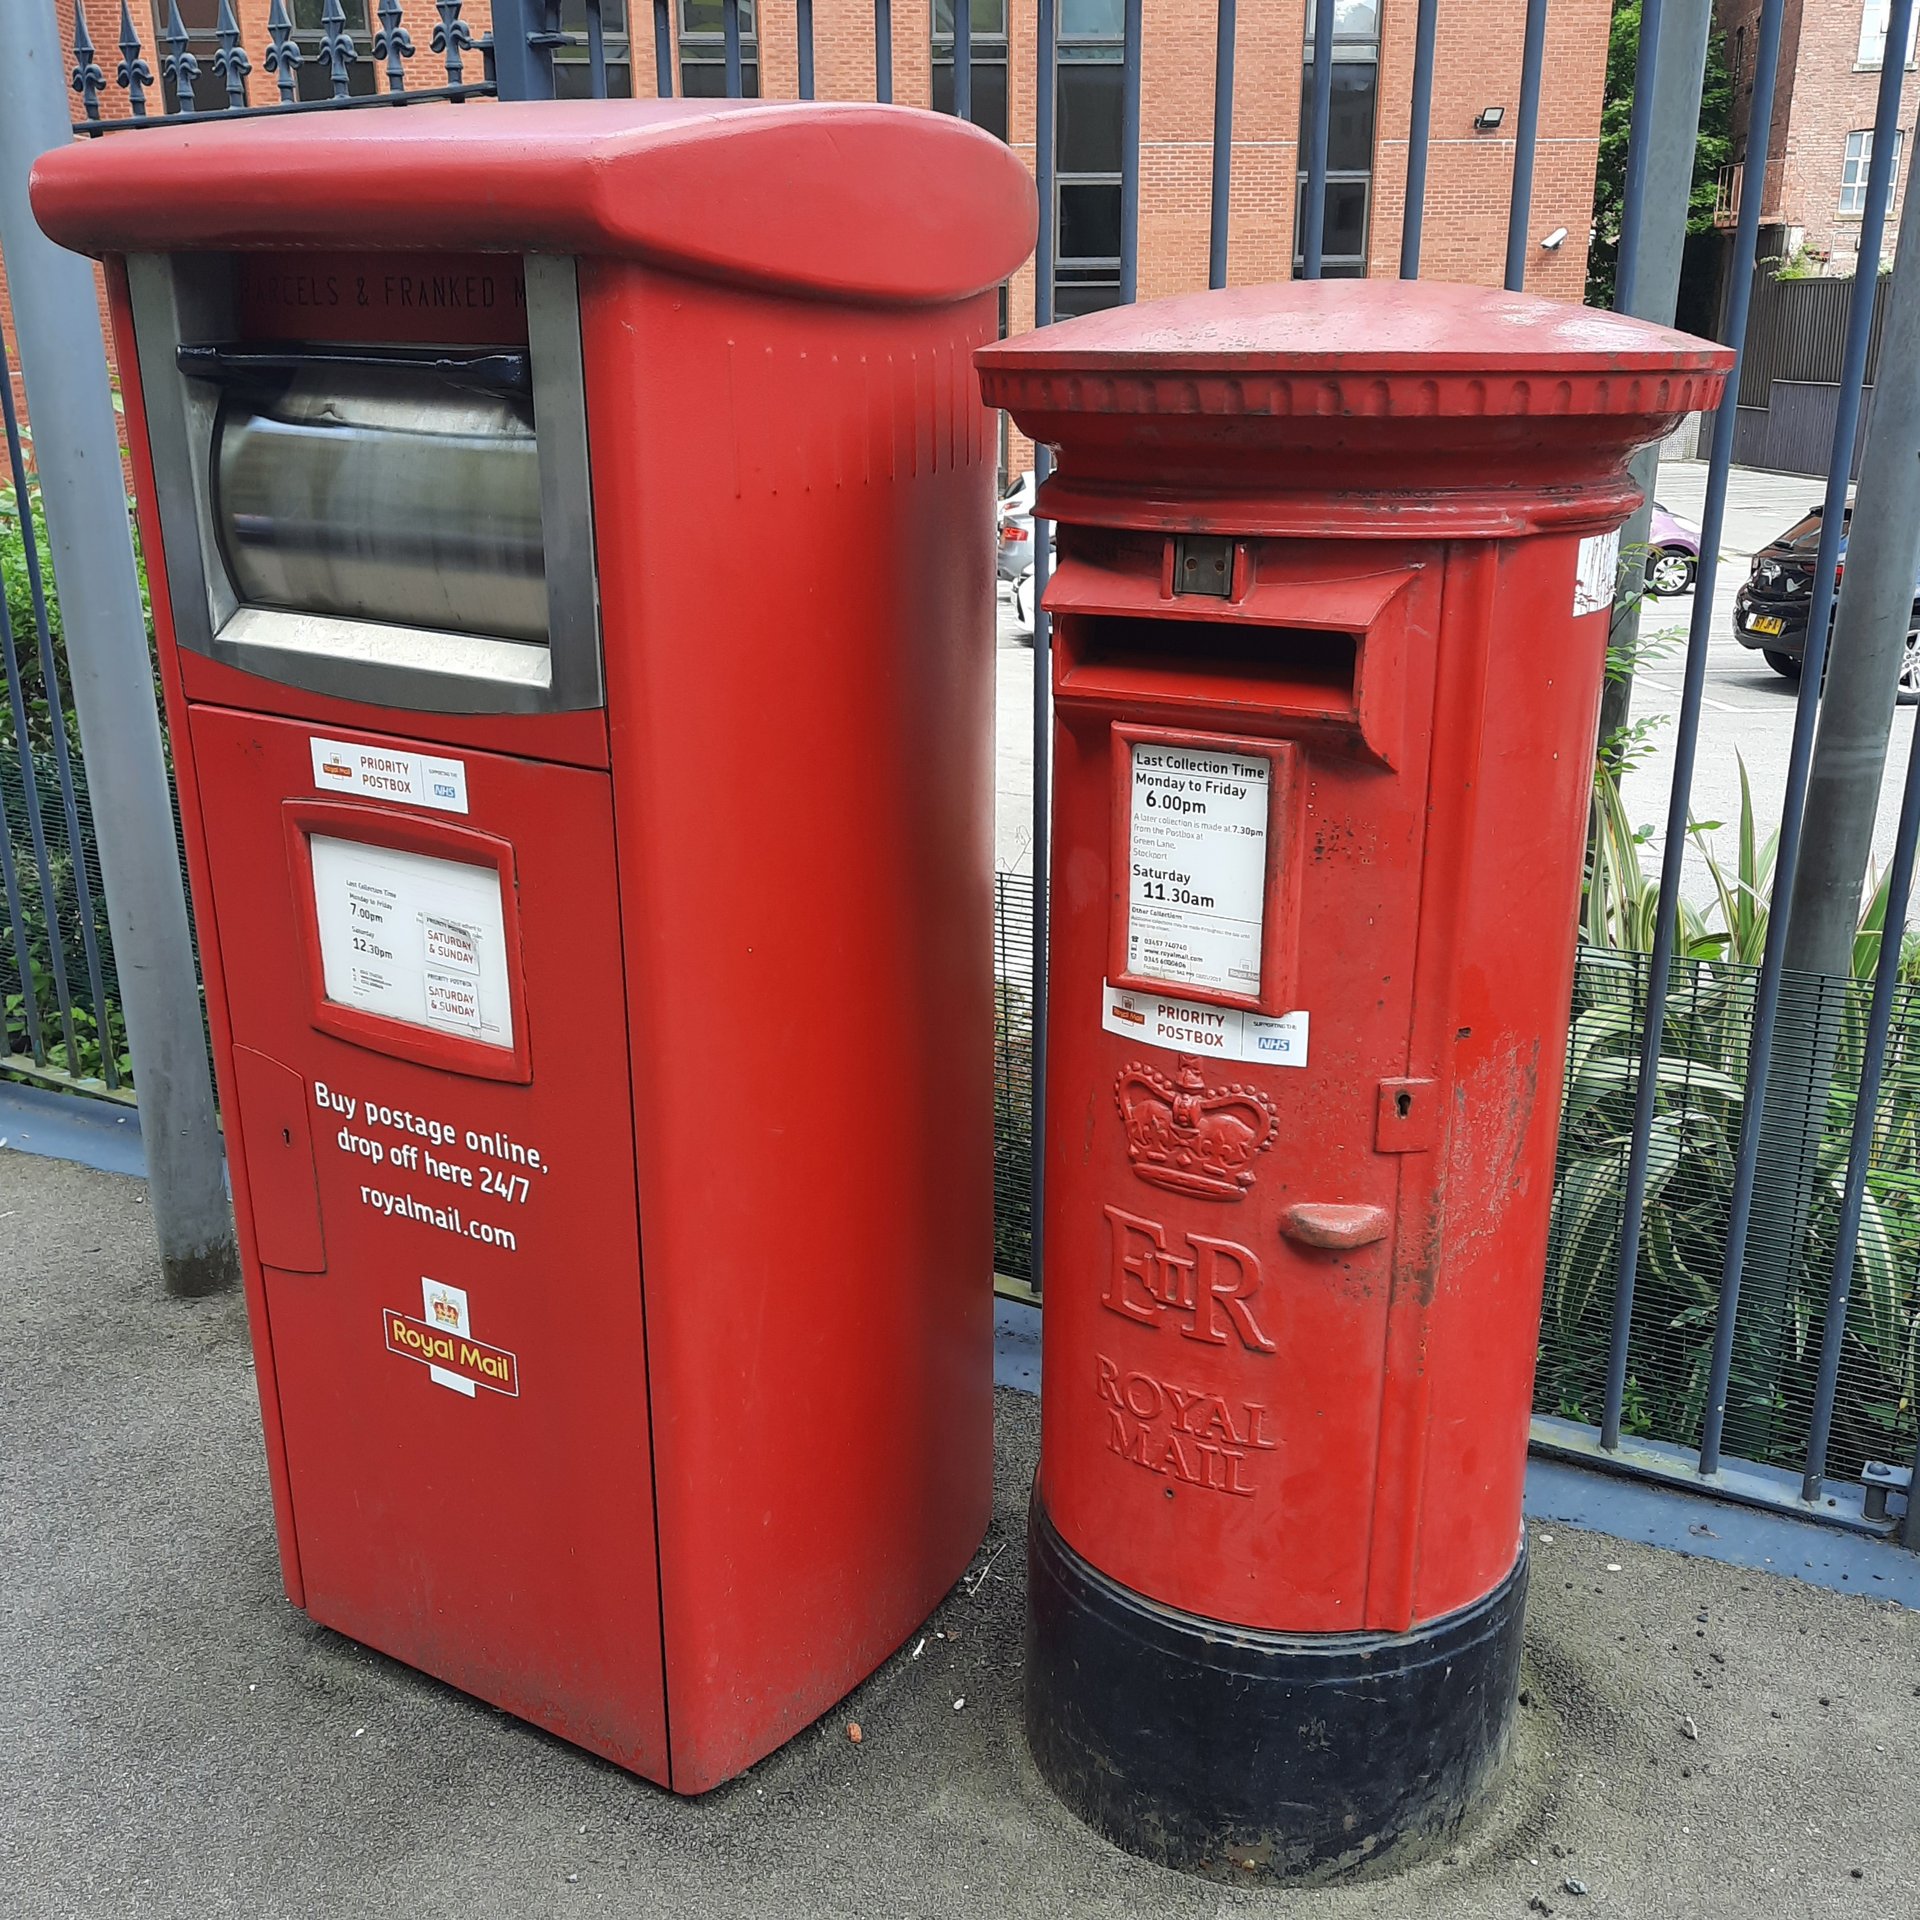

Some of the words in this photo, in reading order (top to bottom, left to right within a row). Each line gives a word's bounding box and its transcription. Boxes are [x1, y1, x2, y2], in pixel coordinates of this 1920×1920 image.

[241, 275, 338, 306] PARCELS
[357, 276, 369, 306] &
[384, 276, 495, 308] FRANKED
[360, 756, 409, 775] PRIORITY
[1136, 752, 1162, 767] Last
[1166, 756, 1228, 774] Collection
[1232, 763, 1265, 778] Time
[362, 774, 412, 793] POSTBOX
[434, 784, 455, 798] NHS
[1136, 772, 1185, 792] Monday
[1189, 780, 1202, 792] to
[1205, 781, 1247, 800] Friday
[1146, 790, 1206, 814] 6.00pm
[1133, 824, 1151, 833] from
[1152, 825, 1164, 835] the
[1166, 828, 1195, 839] Postbox
[1140, 813, 1156, 823] later
[1159, 816, 1193, 828] collection
[1193, 820, 1200, 828] is
[1201, 821, 1222, 831] made
[1232, 825, 1264, 837] 7.30pm
[1133, 835, 1155, 846] Green
[1133, 848, 1167, 860] Stockport
[1133, 863, 1191, 885] Saturday
[345, 880, 357, 888] Last
[384, 889, 397, 898] Time
[1143, 881, 1214, 908] 11.30am
[350, 902, 383, 923] 7.00pm
[1150, 909, 1182, 920] Collections
[352, 937, 393, 959] 12.30pm
[427, 929, 471, 951] SATURDAY
[429, 943, 435, 953] &
[437, 946, 474, 964] SUNDAY
[1144, 948, 1203, 962] www.royalmail.com
[428, 986, 474, 1004] SATURDAY
[431, 1000, 437, 1009] &
[439, 1001, 475, 1017] SUNDAY
[1113, 1007, 1129, 1020] Royal
[1130, 1011, 1144, 1024] Mail
[1157, 1004, 1225, 1027] PRIORITY
[1157, 1023, 1224, 1047] POSTBOX
[1259, 1037, 1289, 1051] NHS
[314, 1081, 356, 1119] Buy
[364, 1101, 456, 1146] postage
[465, 1131, 549, 1174] online,
[337, 1126, 385, 1164] drop
[390, 1144, 418, 1170] off
[424, 1150, 473, 1187] here
[478, 1167, 530, 1204] 24/7
[360, 1185, 517, 1251] royalmail.com
[392, 1318, 455, 1361] Royal
[459, 1343, 509, 1381] Mail
[1095, 1352, 1276, 1450] ROYAL
[1106, 1407, 1256, 1497] MAIL
